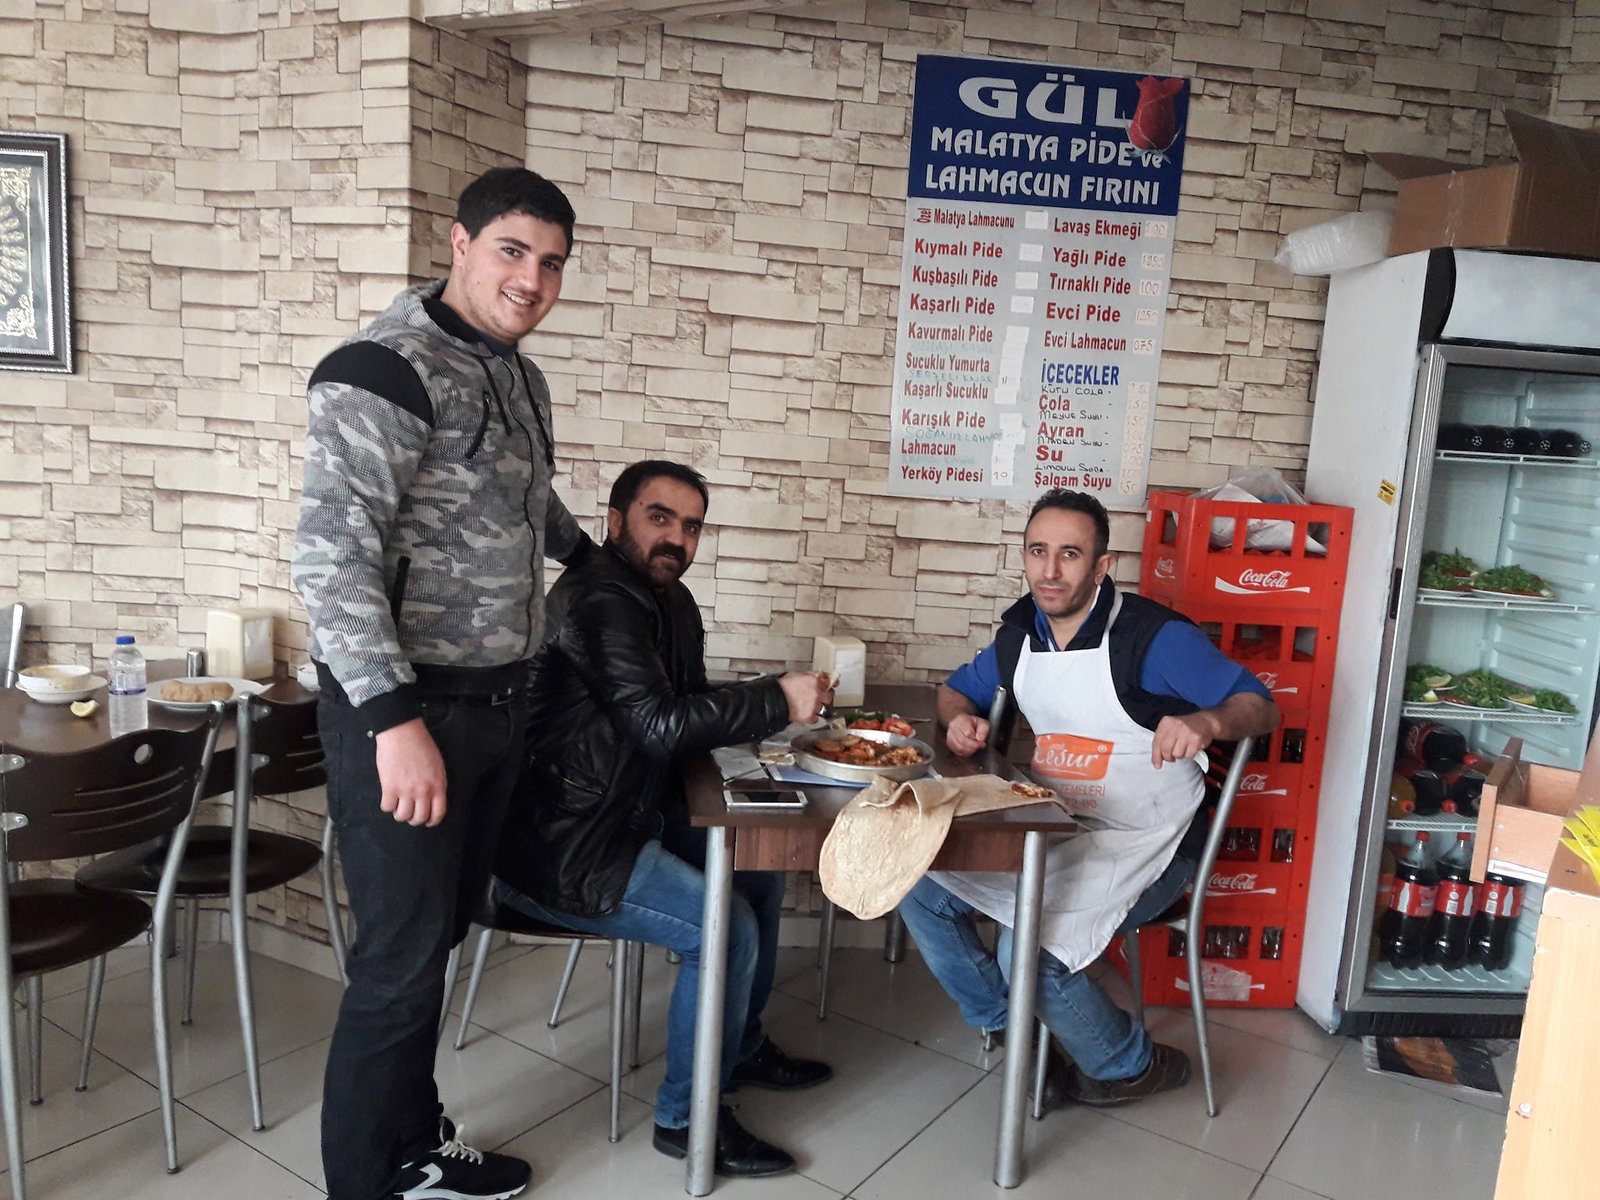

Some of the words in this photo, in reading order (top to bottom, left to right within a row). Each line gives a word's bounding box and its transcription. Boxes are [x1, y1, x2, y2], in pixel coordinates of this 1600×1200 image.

[958, 73, 1133, 128] GÜL
[931, 126, 1059, 162] MALATYA
[1070, 131, 1133, 167] PİDE
[1141, 151, 1162, 169] ve
[925, 164, 1070, 198] LAHMACUN
[1081, 176, 1160, 205] FIRINI
[934, 208, 966, 229] Malatya
[968, 210, 1015, 228] Lahmacunu
[1054, 217, 1090, 236] Lavaş
[1095, 219, 1141, 240] Ekmeği
[914, 238, 967, 258] Kıymalı
[973, 241, 1003, 258] Pide
[1053, 247, 1088, 268] Yağlı
[1094, 250, 1126, 267] Pide
[912, 265, 968, 287] Kuşbaşılı
[972, 269, 998, 287] Pide
[1050, 272, 1099, 293] Tırnaklı
[1103, 276, 1131, 294] Pide
[910, 293, 959, 314] Kaşarlı
[965, 296, 995, 315] Pide
[1046, 302, 1080, 321] Evci
[1086, 304, 1121, 322] Pide
[908, 322, 964, 342] Kavurmalı
[969, 325, 993, 342] Pide
[1044, 330, 1068, 348] Evci
[1071, 332, 1127, 351] Lahmacun
[906, 352, 945, 370] Sucuklu
[949, 354, 990, 372] Yumurta
[904, 380, 942, 400] Kaşarlı
[946, 381, 988, 399] Sucuklu
[1039, 394, 1070, 411] Cola
[901, 409, 951, 429] Karışık
[956, 411, 986, 428] Pide
[1038, 422, 1084, 441] Ayran
[901, 438, 956, 456] Lahmacun
[1036, 445, 1063, 462] Su
[901, 465, 942, 484] Yerköy
[946, 467, 983, 482] Pidesi
[1035, 472, 1078, 490] Şalgam
[1083, 473, 1112, 490] Suyu
